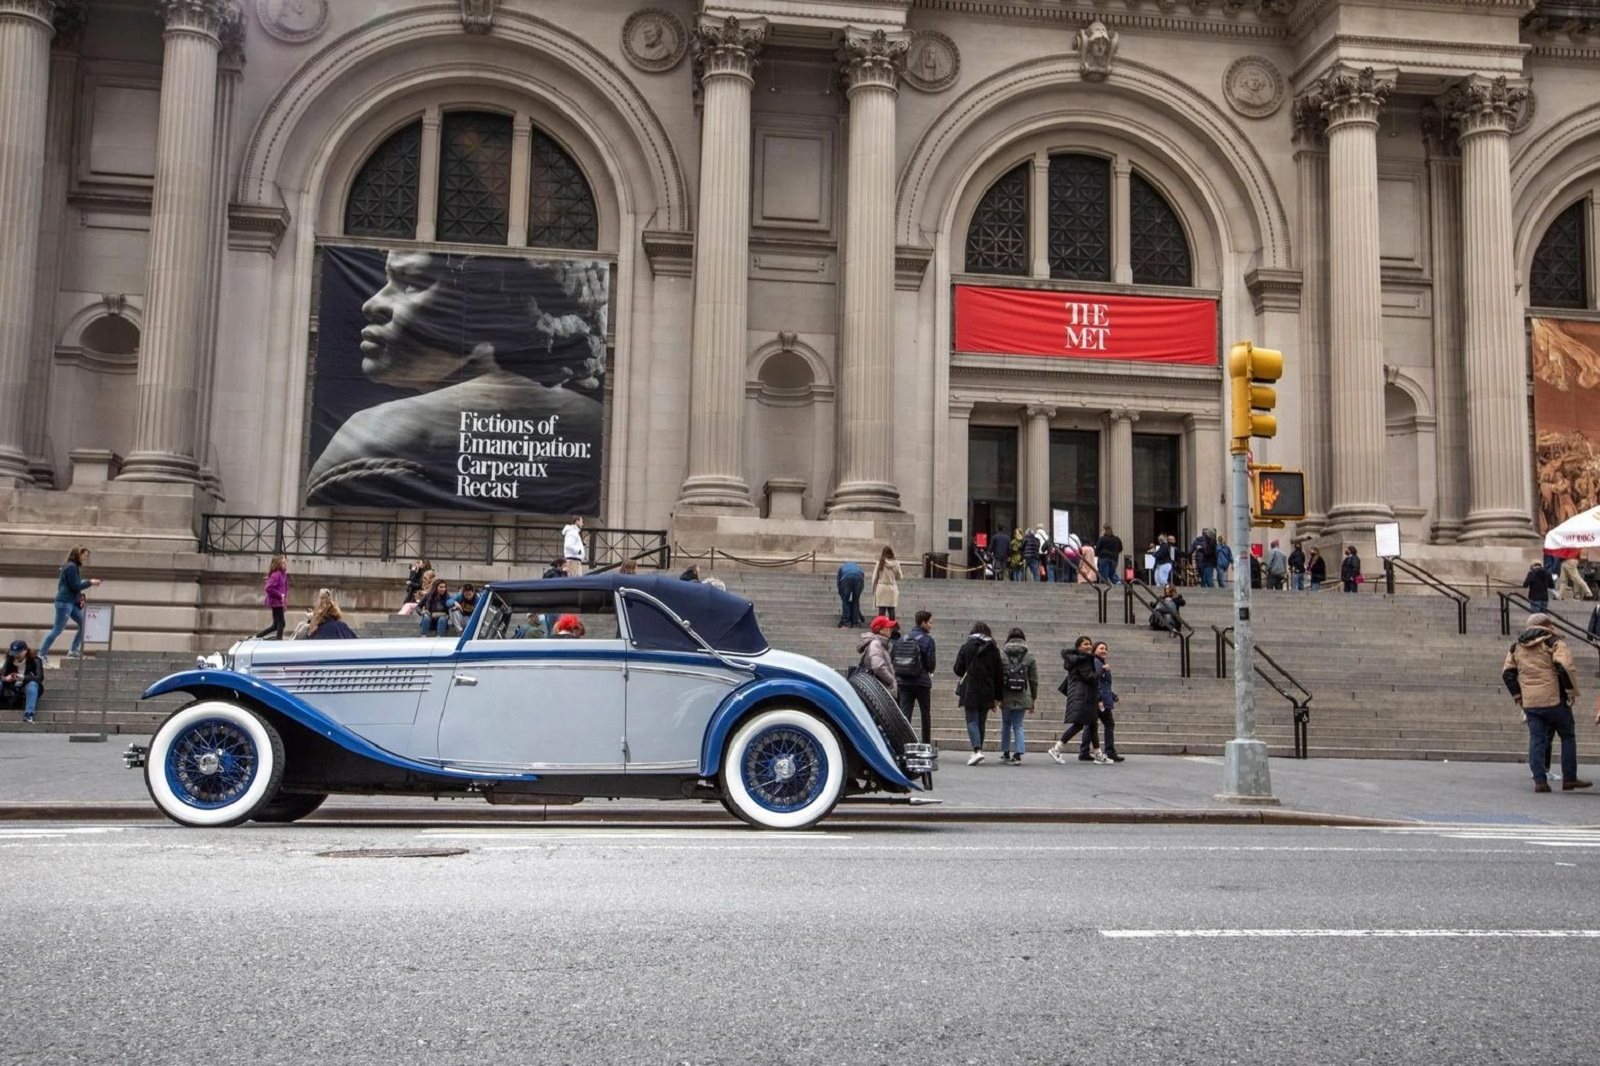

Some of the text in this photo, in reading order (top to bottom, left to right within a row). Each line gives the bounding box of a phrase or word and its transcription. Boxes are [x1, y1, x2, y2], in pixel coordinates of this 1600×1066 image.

[1065, 302, 1110, 326] THE
[1064, 326, 1111, 350] MET
[459, 411, 559, 435] Fictions of
[458, 432, 591, 461] Emancipation:
[457, 454, 548, 481] Carpeaux
[456, 475, 520, 499] Recast
